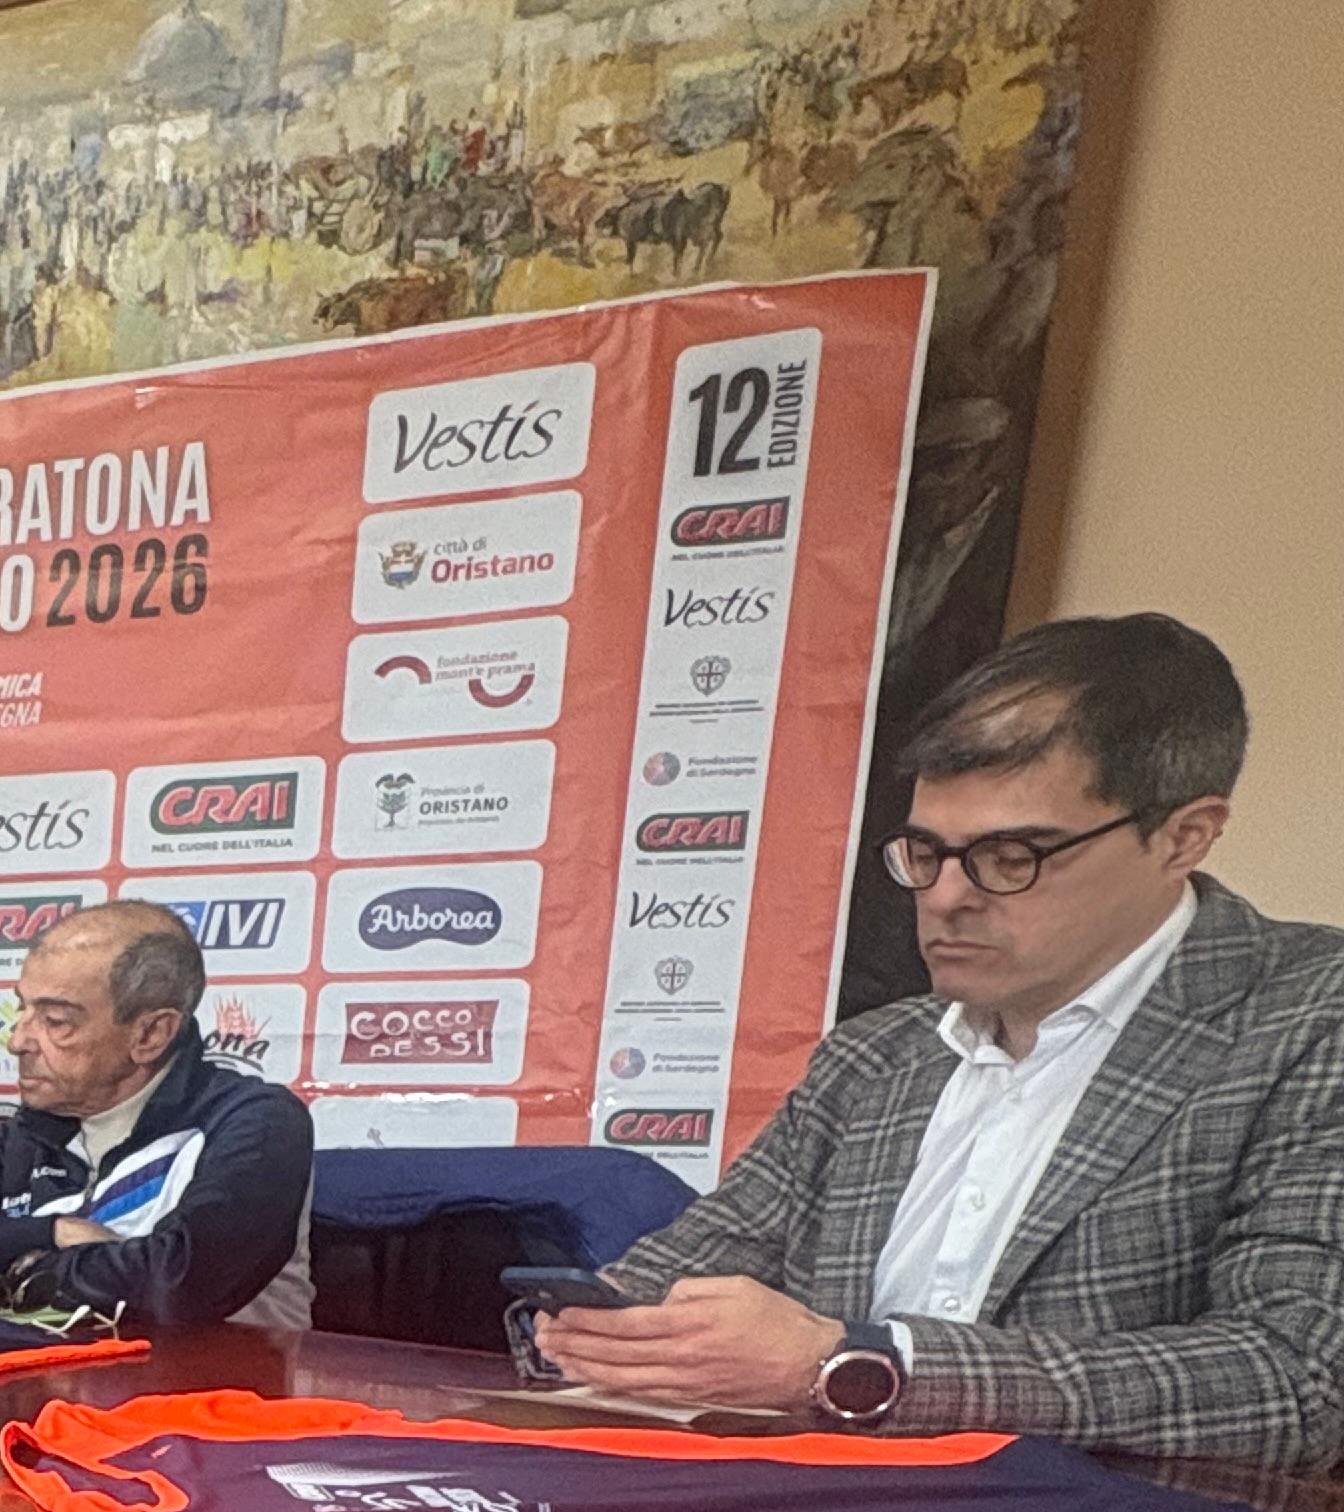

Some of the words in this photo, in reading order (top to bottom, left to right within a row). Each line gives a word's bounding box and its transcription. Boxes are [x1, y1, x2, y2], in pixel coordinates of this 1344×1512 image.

[688, 366, 771, 477] 12
[766, 357, 808, 470] EDIZIONE
[393, 400, 562, 473] Vestis
[676, 502, 785, 543] CRAI
[46, 532, 210, 629] 2026
[431, 552, 555, 584] Oristano
[663, 585, 776, 629] Vestis
[158, 779, 291, 828] CRAI
[419, 796, 508, 816] ORISTANO
[642, 815, 743, 848] CRAI
[367, 904, 496, 934] Arborea
[629, 890, 736, 929] Vestis
[350, 1009, 473, 1041] COCCO
[610, 1112, 708, 1142] CRAI
